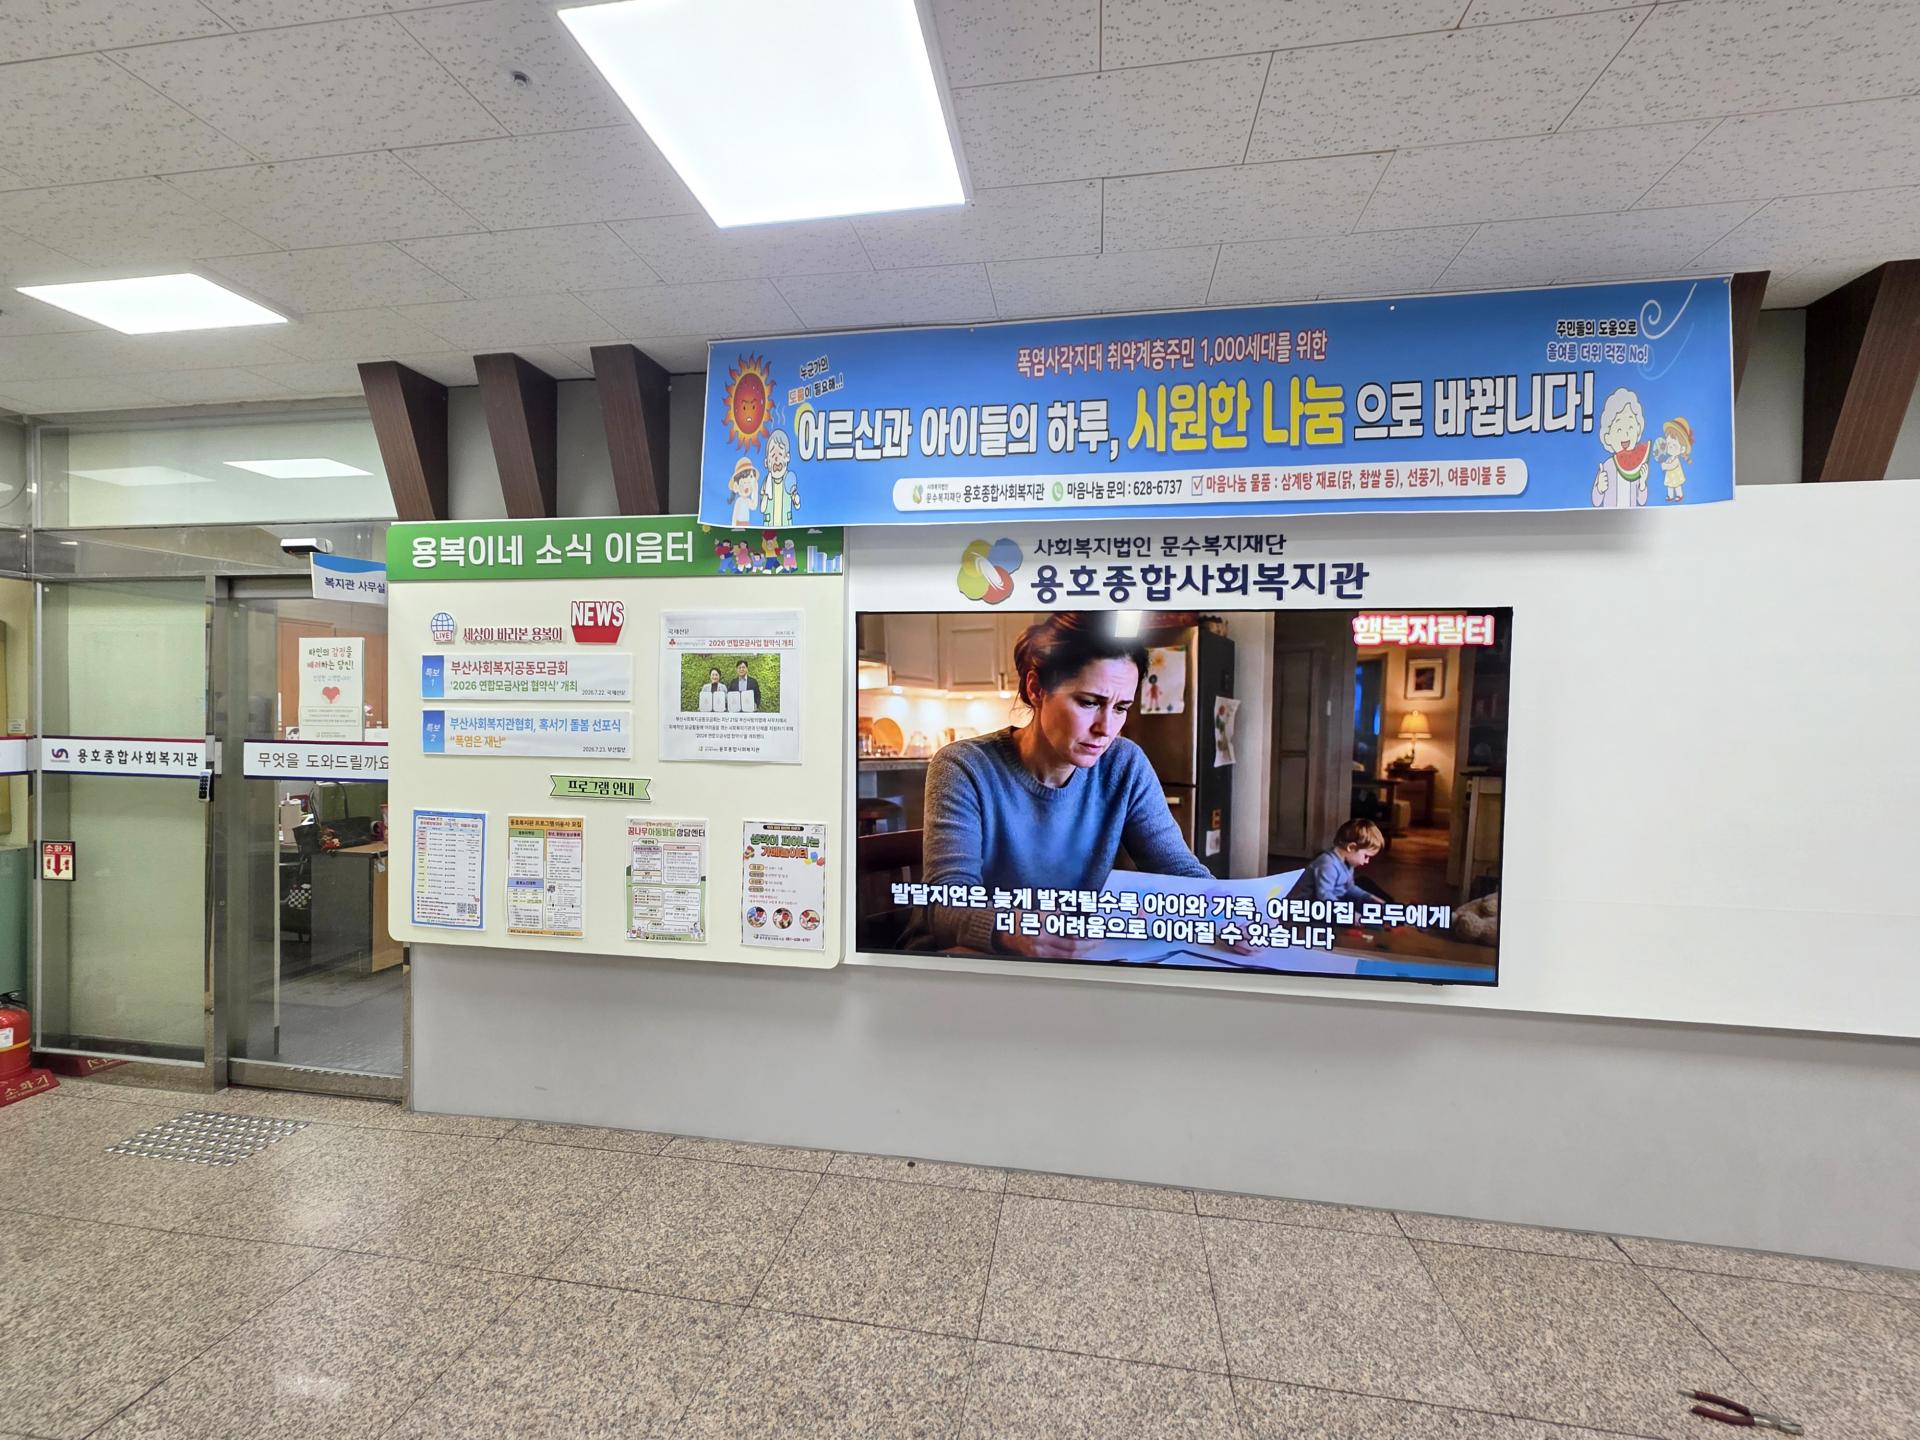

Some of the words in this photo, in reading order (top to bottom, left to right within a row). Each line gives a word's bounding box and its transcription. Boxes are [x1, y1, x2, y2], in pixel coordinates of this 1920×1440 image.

[1556, 319, 1595, 337] 주민들의
[1598, 319, 1638, 336] 도움으로
[1017, 343, 1104, 379] 폭염사각지대
[1107, 336, 1196, 372] 취약계층주민
[1200, 331, 1292, 367] 1,000세대를
[1296, 329, 1328, 361] 위한
[1547, 342, 1577, 362] 올여름
[1580, 342, 1602, 362] 더위
[1605, 342, 1626, 364] 걱정
[1629, 344, 1649, 363] No!
[800, 354, 829, 380] 누군가의
[788, 386, 812, 406] 도움이
[798, 408, 914, 461] 어르신과
[920, 402, 1039, 457] 아이들의
[1047, 399, 1120, 462] 하루,
[1127, 379, 1252, 453] 시원한
[1262, 375, 1346, 447] 나눔
[1353, 380, 1425, 440] 으로
[1433, 370, 1595, 437] 바뀝니다!
[1206, 475, 1247, 494] 마음나눔
[1250, 474, 1272, 492] 물품
[1281, 471, 1313, 491] 삼계탕
[1316, 470, 1356, 490] 재료(닭,
[1359, 469, 1382, 488] 찹쌀
[1384, 468, 1404, 488] 등),
[1407, 467, 1444, 487] 선풍기,
[1447, 466, 1493, 485] 여름이불
[1495, 465, 1507, 484] 등
[963, 483, 1045, 503] 용호종합사회복지관
[1067, 482, 1105, 499] 마음나눔
[1107, 480, 1126, 498] 문의
[1133, 480, 1183, 495] 628-6737
[412, 534, 523, 568] 용복이네
[536, 533, 592, 565] 소식
[605, 531, 693, 563] 이음터
[1034, 537, 1152, 558] 사회복지법인
[1160, 534, 1287, 557] 문수복지재단
[324, 577, 355, 590] 복지관
[358, 581, 386, 593] 사무실
[1030, 562, 1370, 603] 용호종합사회복지관
[571, 601, 625, 627] NEWS
[434, 632, 450, 640] LIVE
[463, 627, 494, 642] 세상이
[531, 627, 563, 642] 용복이
[1352, 614, 1495, 647] 행복자람터
[309, 647, 329, 658] 타인의
[425, 668, 440, 678] 특보
[451, 660, 568, 676] 부산사회복지공동모금회
[479, 680, 528, 692] 연합모금사업
[560, 680, 578, 692] 개최
[425, 723, 440, 733] 특보
[450, 717, 536, 733] 부산사회복지관협회,
[539, 718, 568, 733] 혹서기
[570, 718, 589, 732] 돌봄
[592, 718, 621, 733] 선포식
[77, 749, 199, 768] 용호종합사회복지관
[258, 752, 299, 769] 무엇을
[568, 780, 609, 796] 프로그램
[612, 782, 635, 797] 안내
[891, 883, 989, 909] 발달지연은
[993, 887, 1032, 910] 늦게
[1037, 889, 1141, 916] 발견될수록
[1143, 893, 1207, 918] 아이와
[1211, 896, 1263, 922] 가족,
[1267, 899, 1354, 925] 어린이집
[1360, 904, 1451, 929] 모두에게
[997, 912, 1015, 935] 더
[1021, 915, 1041, 936] 큰
[1045, 916, 1148, 941] 어려움으로
[1152, 919, 1215, 944] 이어질
[1220, 923, 1243, 943] 수
[1248, 924, 1336, 950] 있습니다
